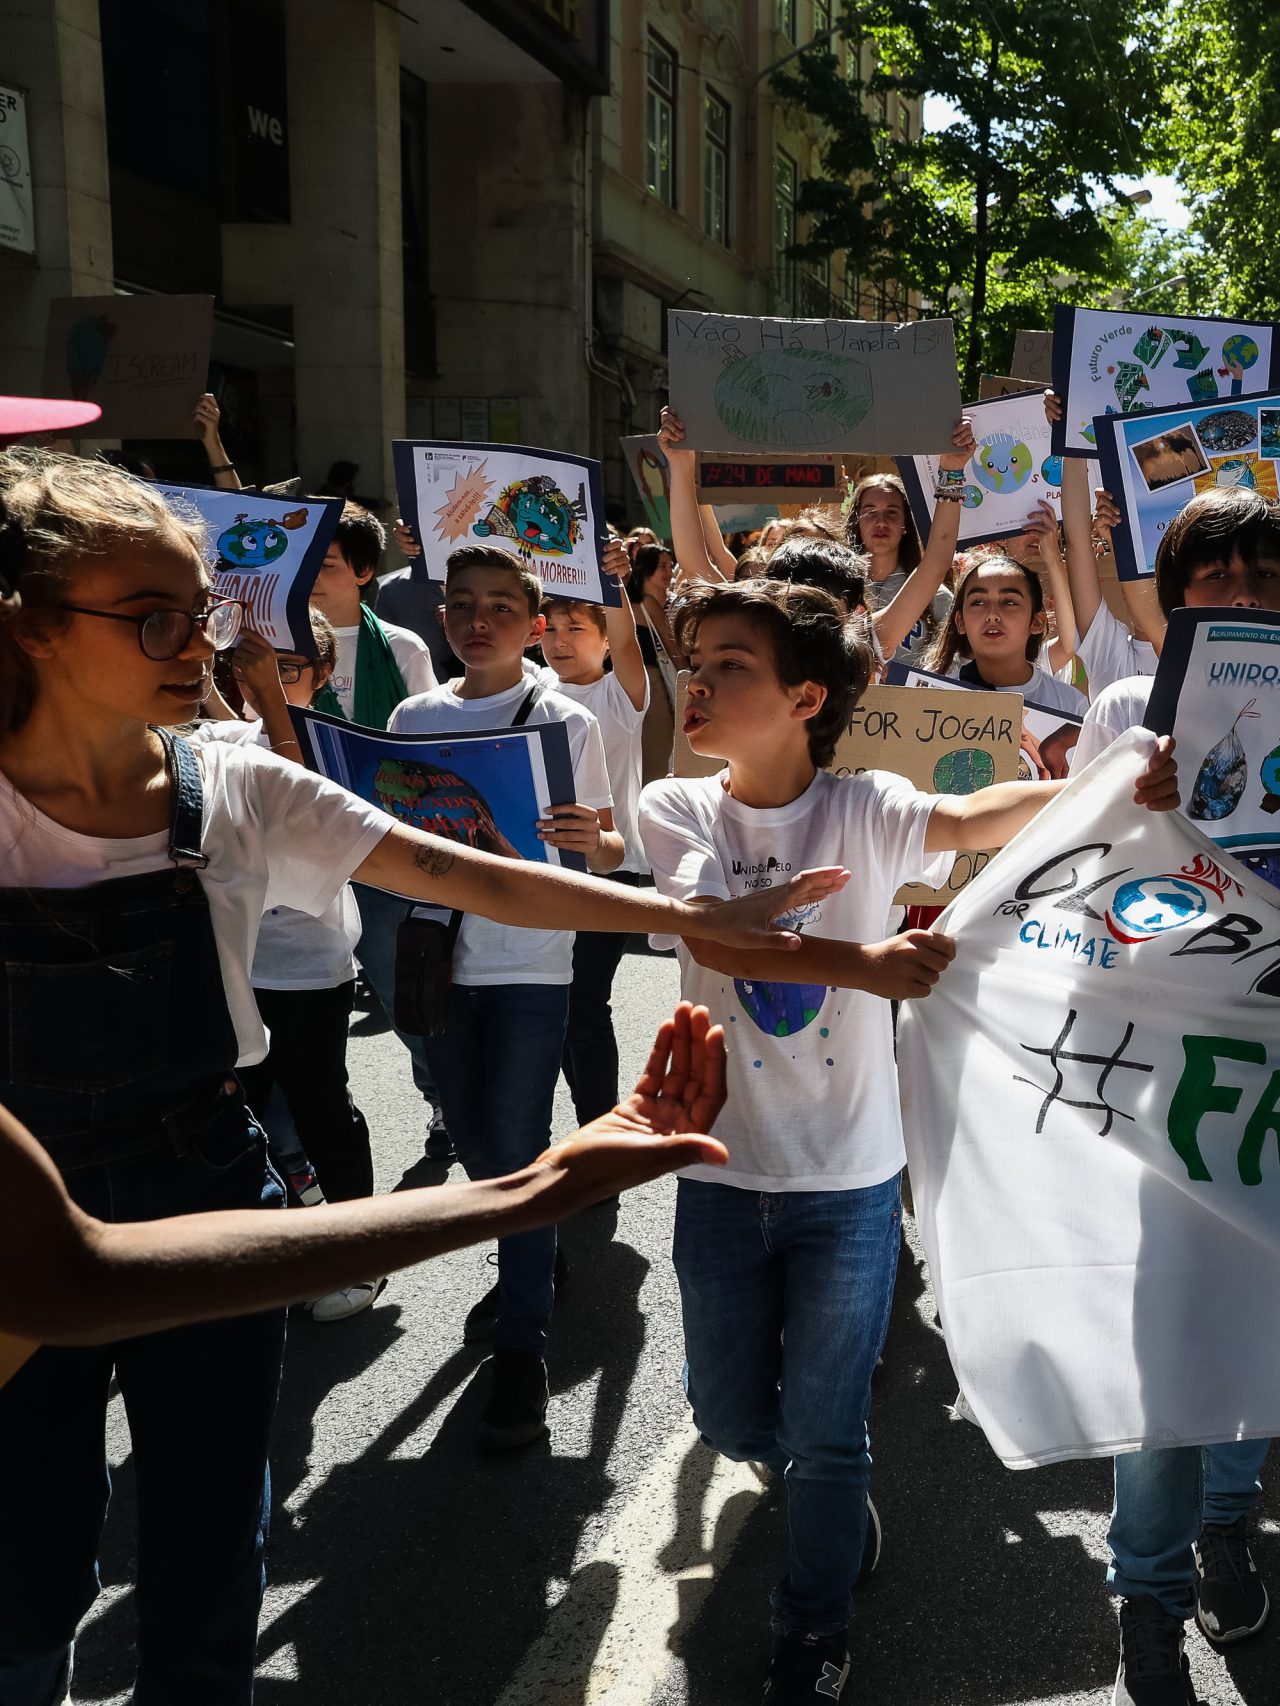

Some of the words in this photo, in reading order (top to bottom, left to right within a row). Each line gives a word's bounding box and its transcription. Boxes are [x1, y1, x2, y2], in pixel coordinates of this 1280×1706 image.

[248, 105, 283, 145] we
[675, 316, 741, 343] Não
[129, 353, 197, 379] SCREAM
[1088, 344, 1103, 383] Futuro
[1100, 325, 1133, 344] Verde
[540, 560, 587, 586] MORRER!!!
[1210, 630, 1259, 640] AGRUPAMENTO
[915, 709, 1014, 744] JOGAR
[732, 859, 766, 876] UNIDO
[766, 856, 792, 873] PELO
[992, 899, 1030, 922] FOR
[1018, 919, 1120, 970] CLIMATE
